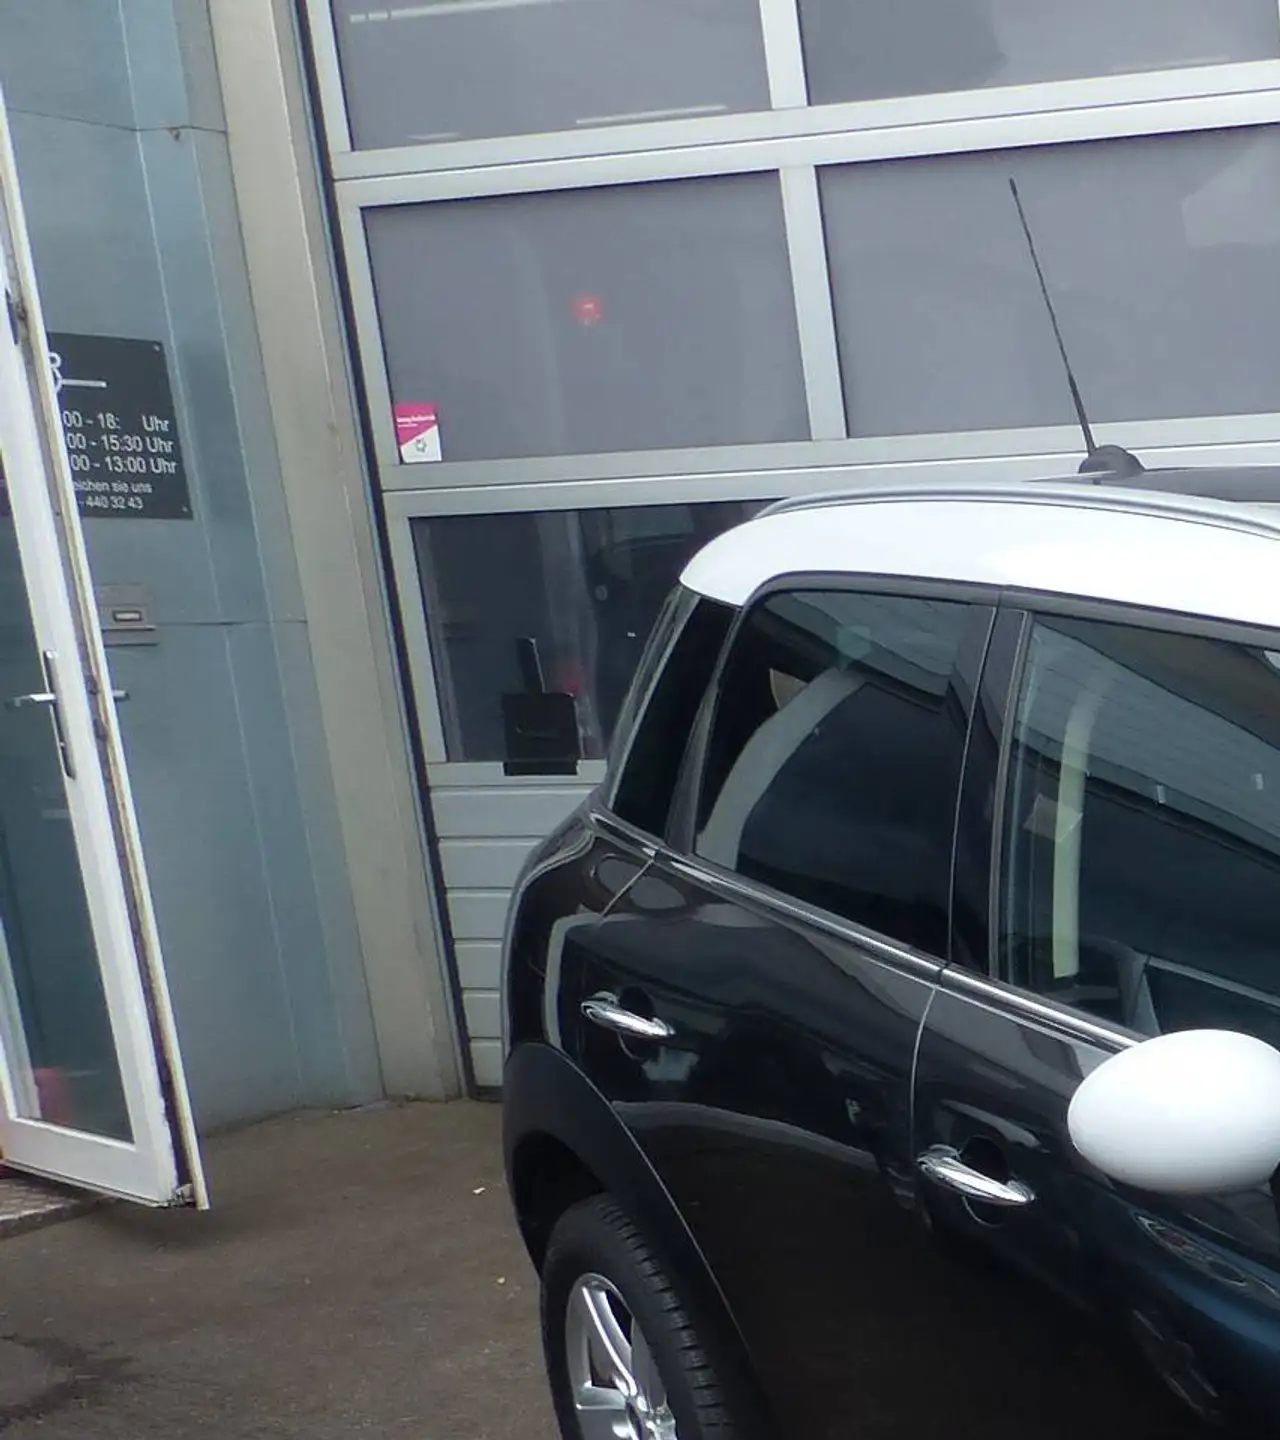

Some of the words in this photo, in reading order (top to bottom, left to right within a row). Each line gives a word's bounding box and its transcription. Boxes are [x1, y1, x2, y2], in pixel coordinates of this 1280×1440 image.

[141, 414, 170, 432] Uhr
[100, 434, 143, 452] 15:30
[144, 436, 174, 454] Uhr
[104, 455, 147, 473] 13:00
[149, 457, 178, 474] Uhr
